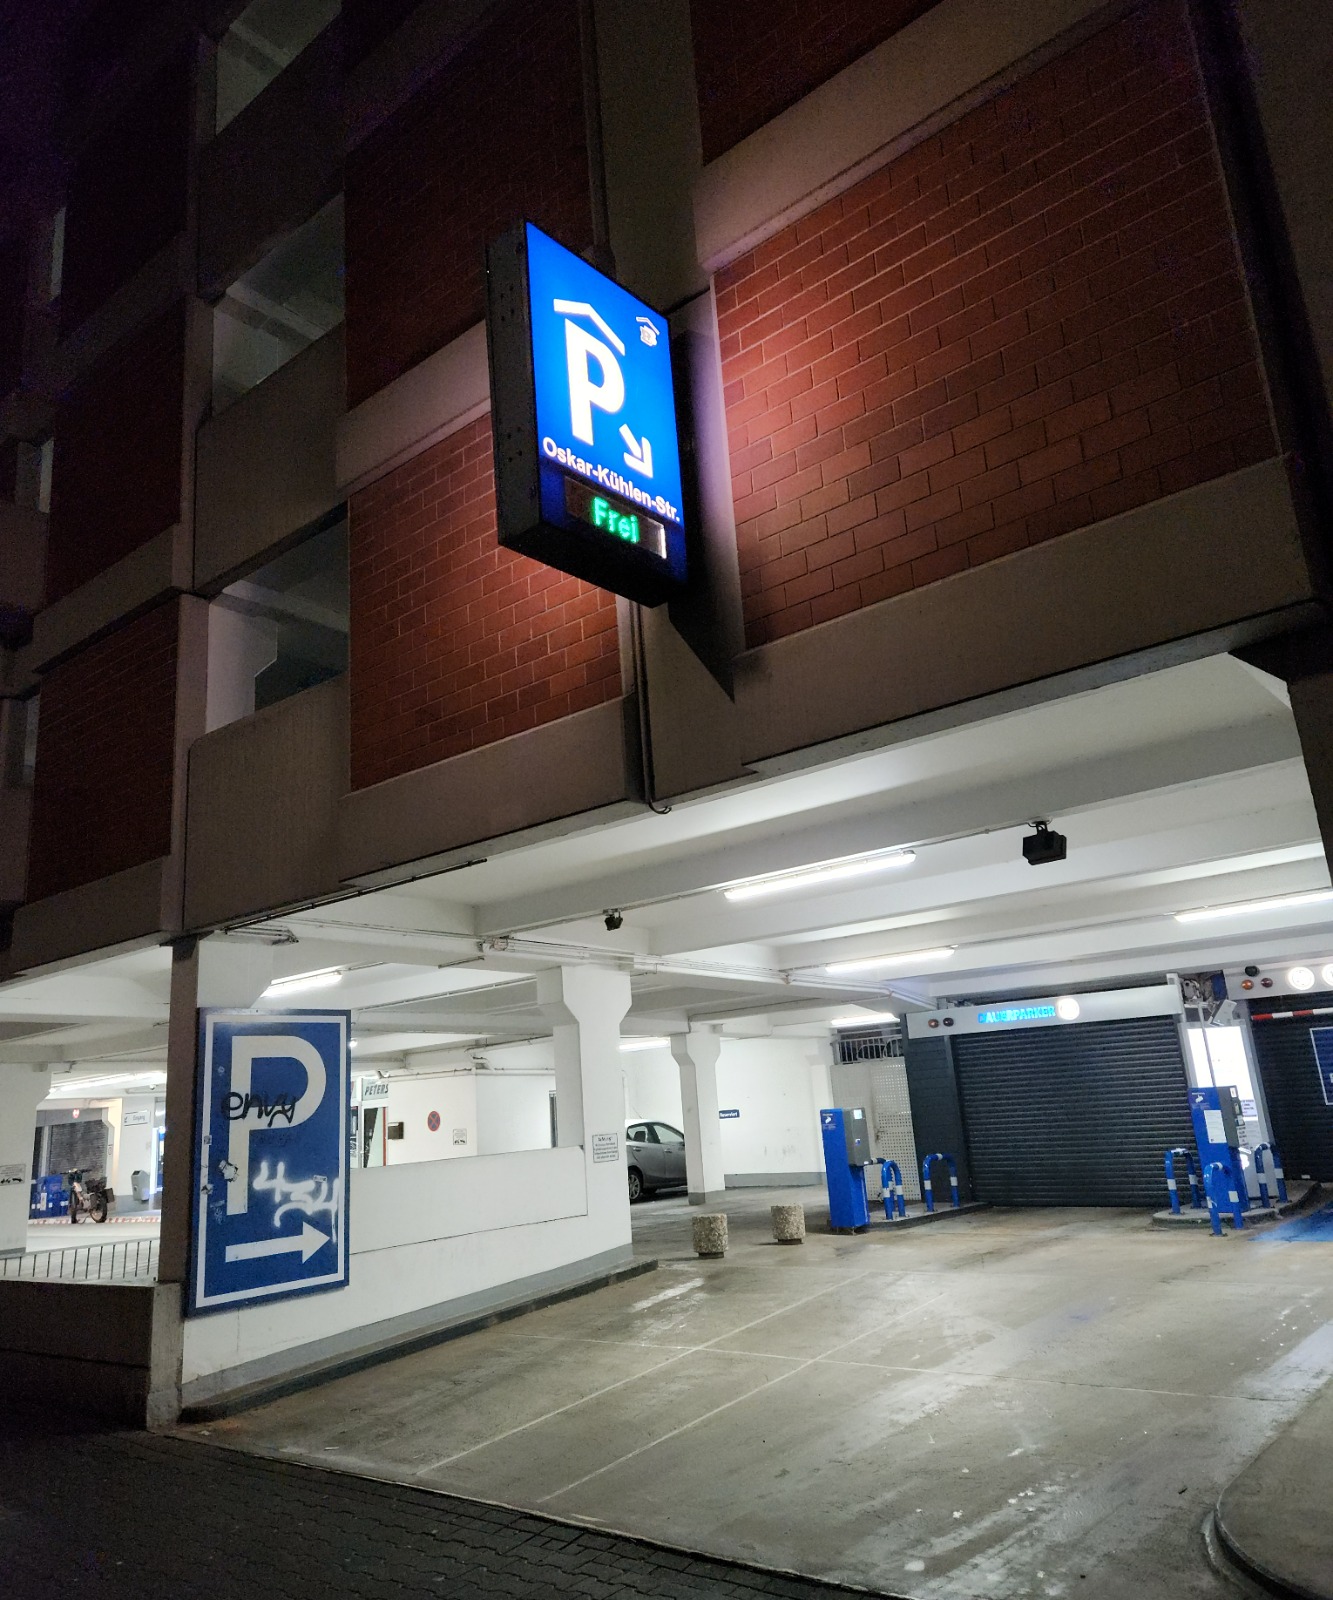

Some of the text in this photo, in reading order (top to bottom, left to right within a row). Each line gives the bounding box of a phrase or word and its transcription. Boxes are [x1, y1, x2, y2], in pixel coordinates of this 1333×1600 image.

[565, 317, 625, 446] P
[543, 436, 680, 523] Oskar-Kühlen-Str.
[592, 496, 639, 544] Frei
[978, 1006, 1056, 1024] DAUERPARKER
[365, 1083, 389, 1096] PETERS
[226, 1035, 327, 1216] P
